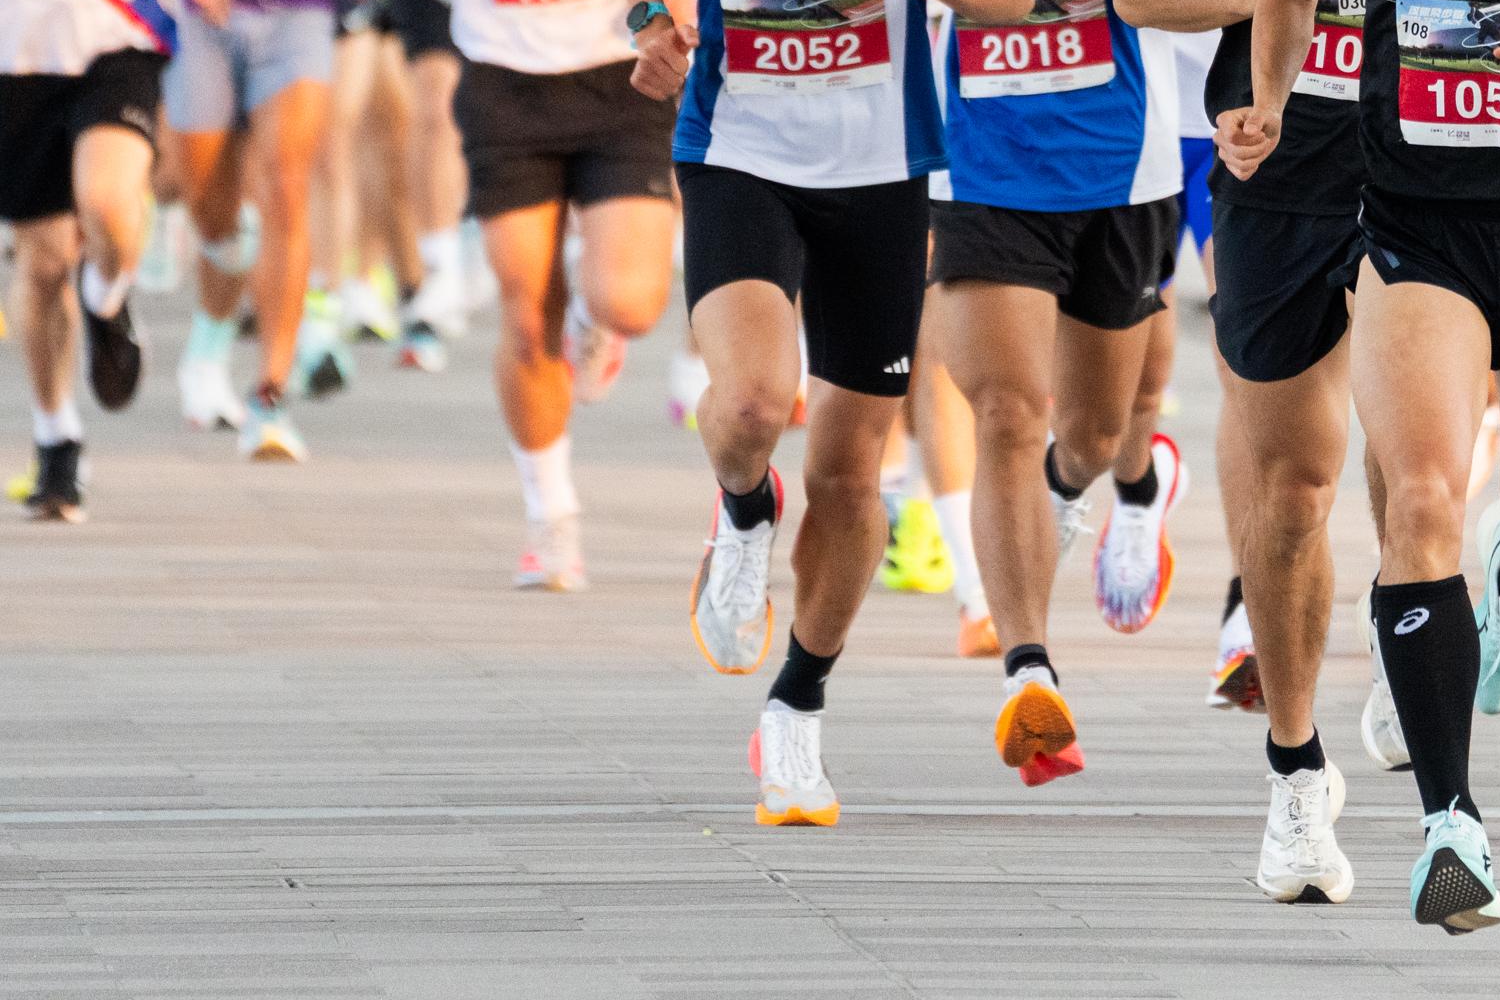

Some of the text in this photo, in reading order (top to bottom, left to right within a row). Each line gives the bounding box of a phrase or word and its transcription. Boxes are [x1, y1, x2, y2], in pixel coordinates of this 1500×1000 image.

[981, 28, 1085, 71] 2018
[1402, 20, 1429, 39] 108
[753, 32, 862, 72] 2052
